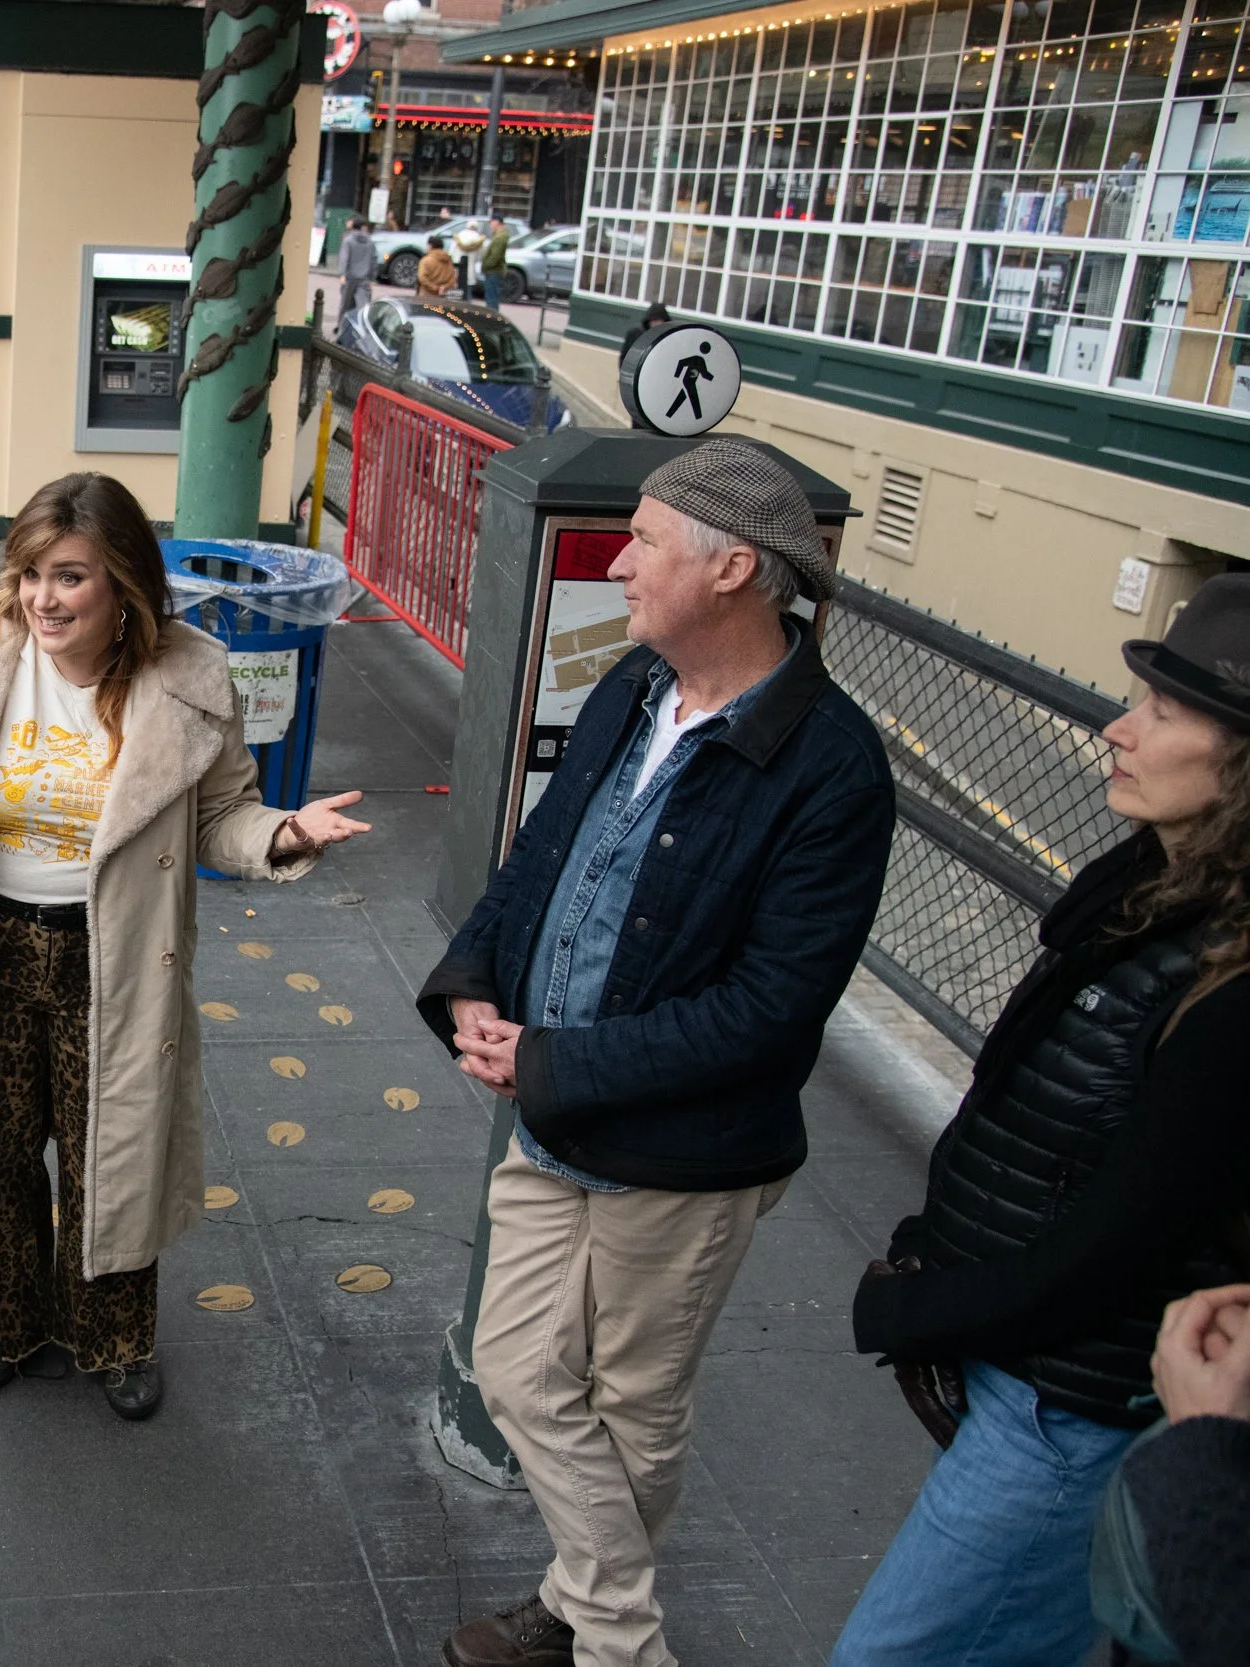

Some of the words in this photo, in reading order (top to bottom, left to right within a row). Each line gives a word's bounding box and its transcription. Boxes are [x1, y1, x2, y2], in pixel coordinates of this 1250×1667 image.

[146, 263, 186, 273] ATM
[229, 665, 289, 679] ECYCLE
[62, 795, 105, 812] CENT
